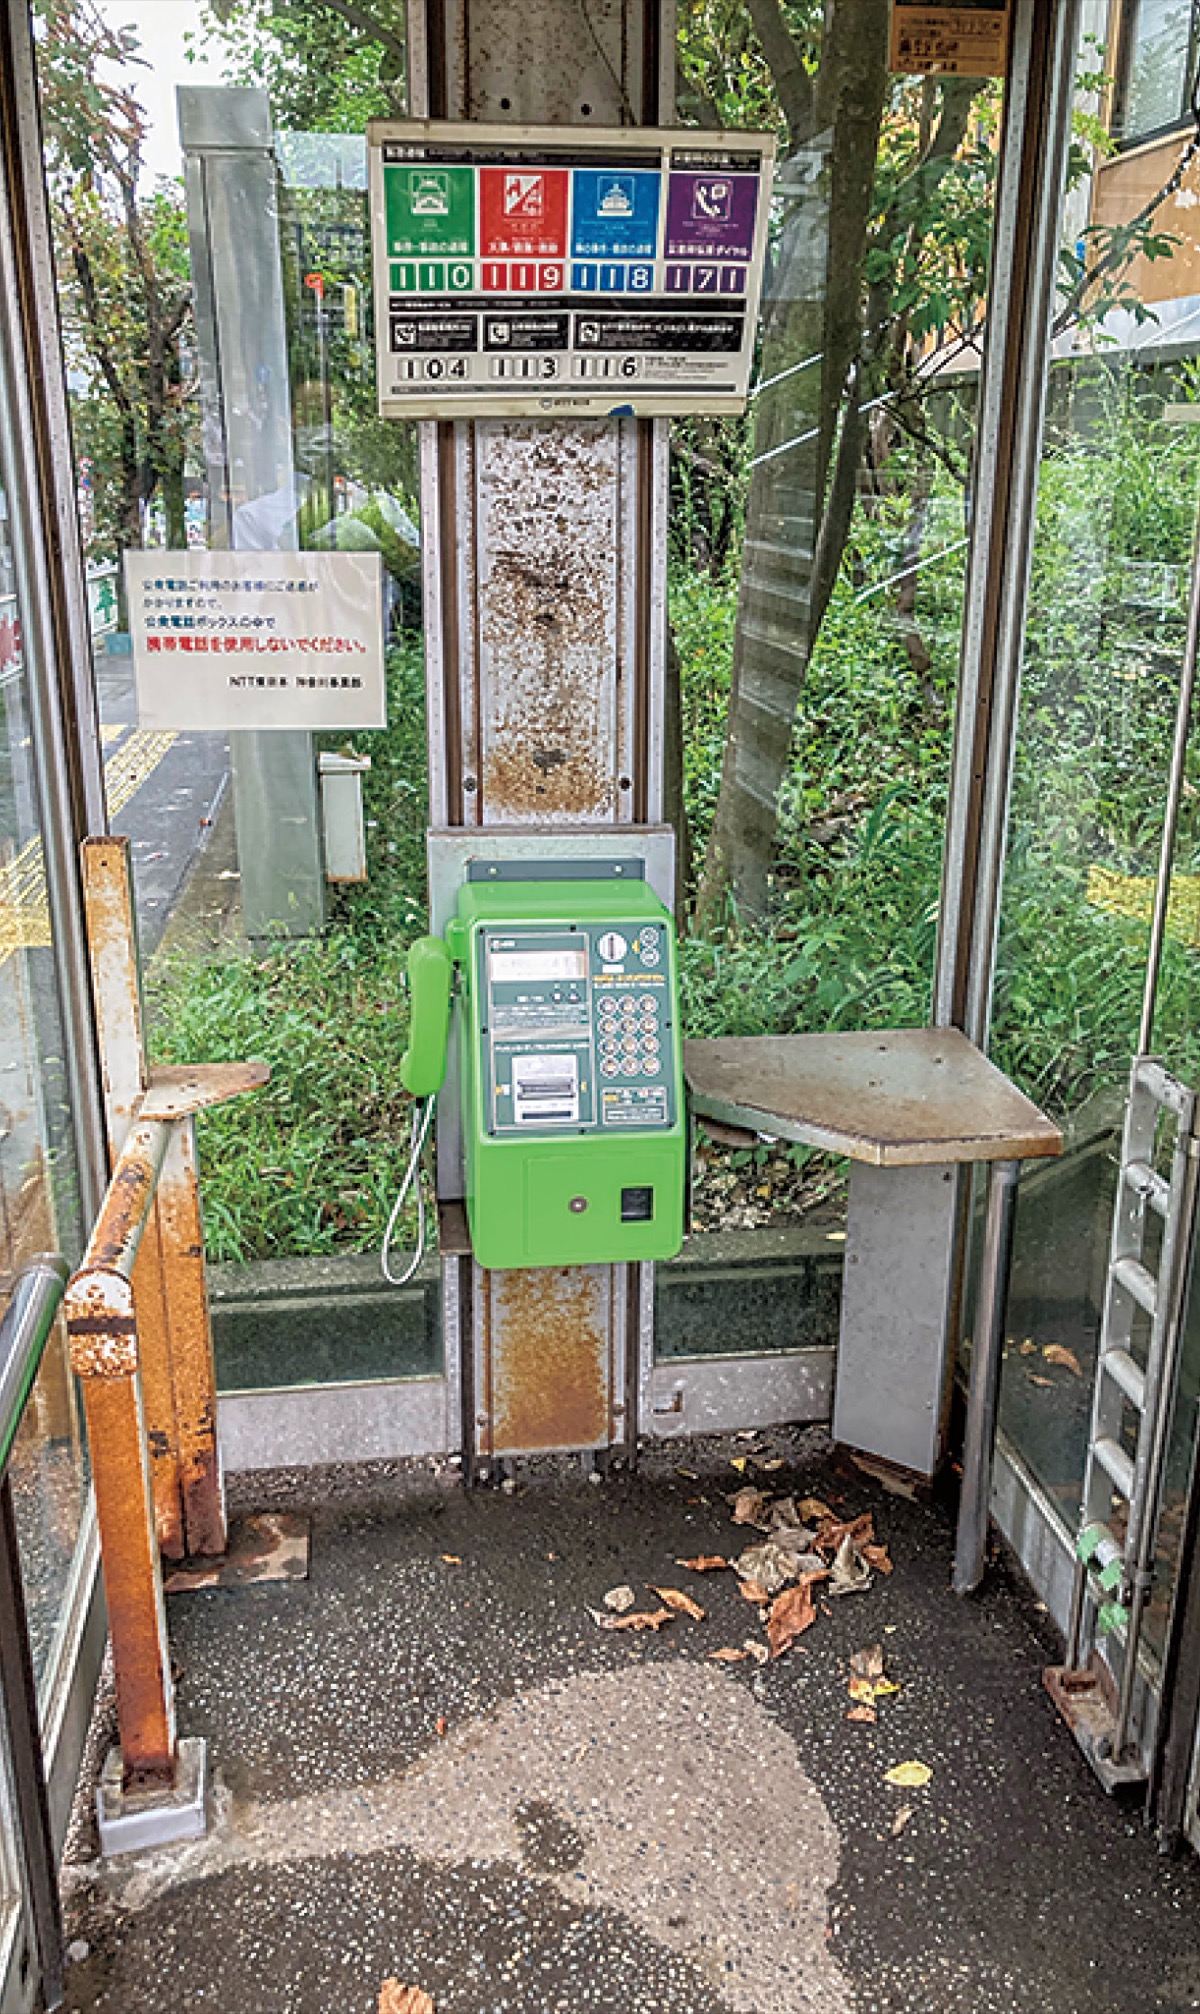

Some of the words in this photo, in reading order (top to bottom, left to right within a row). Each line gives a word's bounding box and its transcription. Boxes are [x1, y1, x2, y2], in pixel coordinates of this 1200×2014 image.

[398, 266, 471, 289] 110
[489, 266, 560, 289] 119
[580, 266, 650, 290] 118
[674, 267, 737, 291] 171
[408, 358, 465, 377] 104
[500, 358, 557, 377] 113
[581, 358, 636, 377] 116
[145, 615, 276, 629] 公衆電話ボックスの中で
[147, 636, 367, 653] 携帯電話を使用しないでください。
